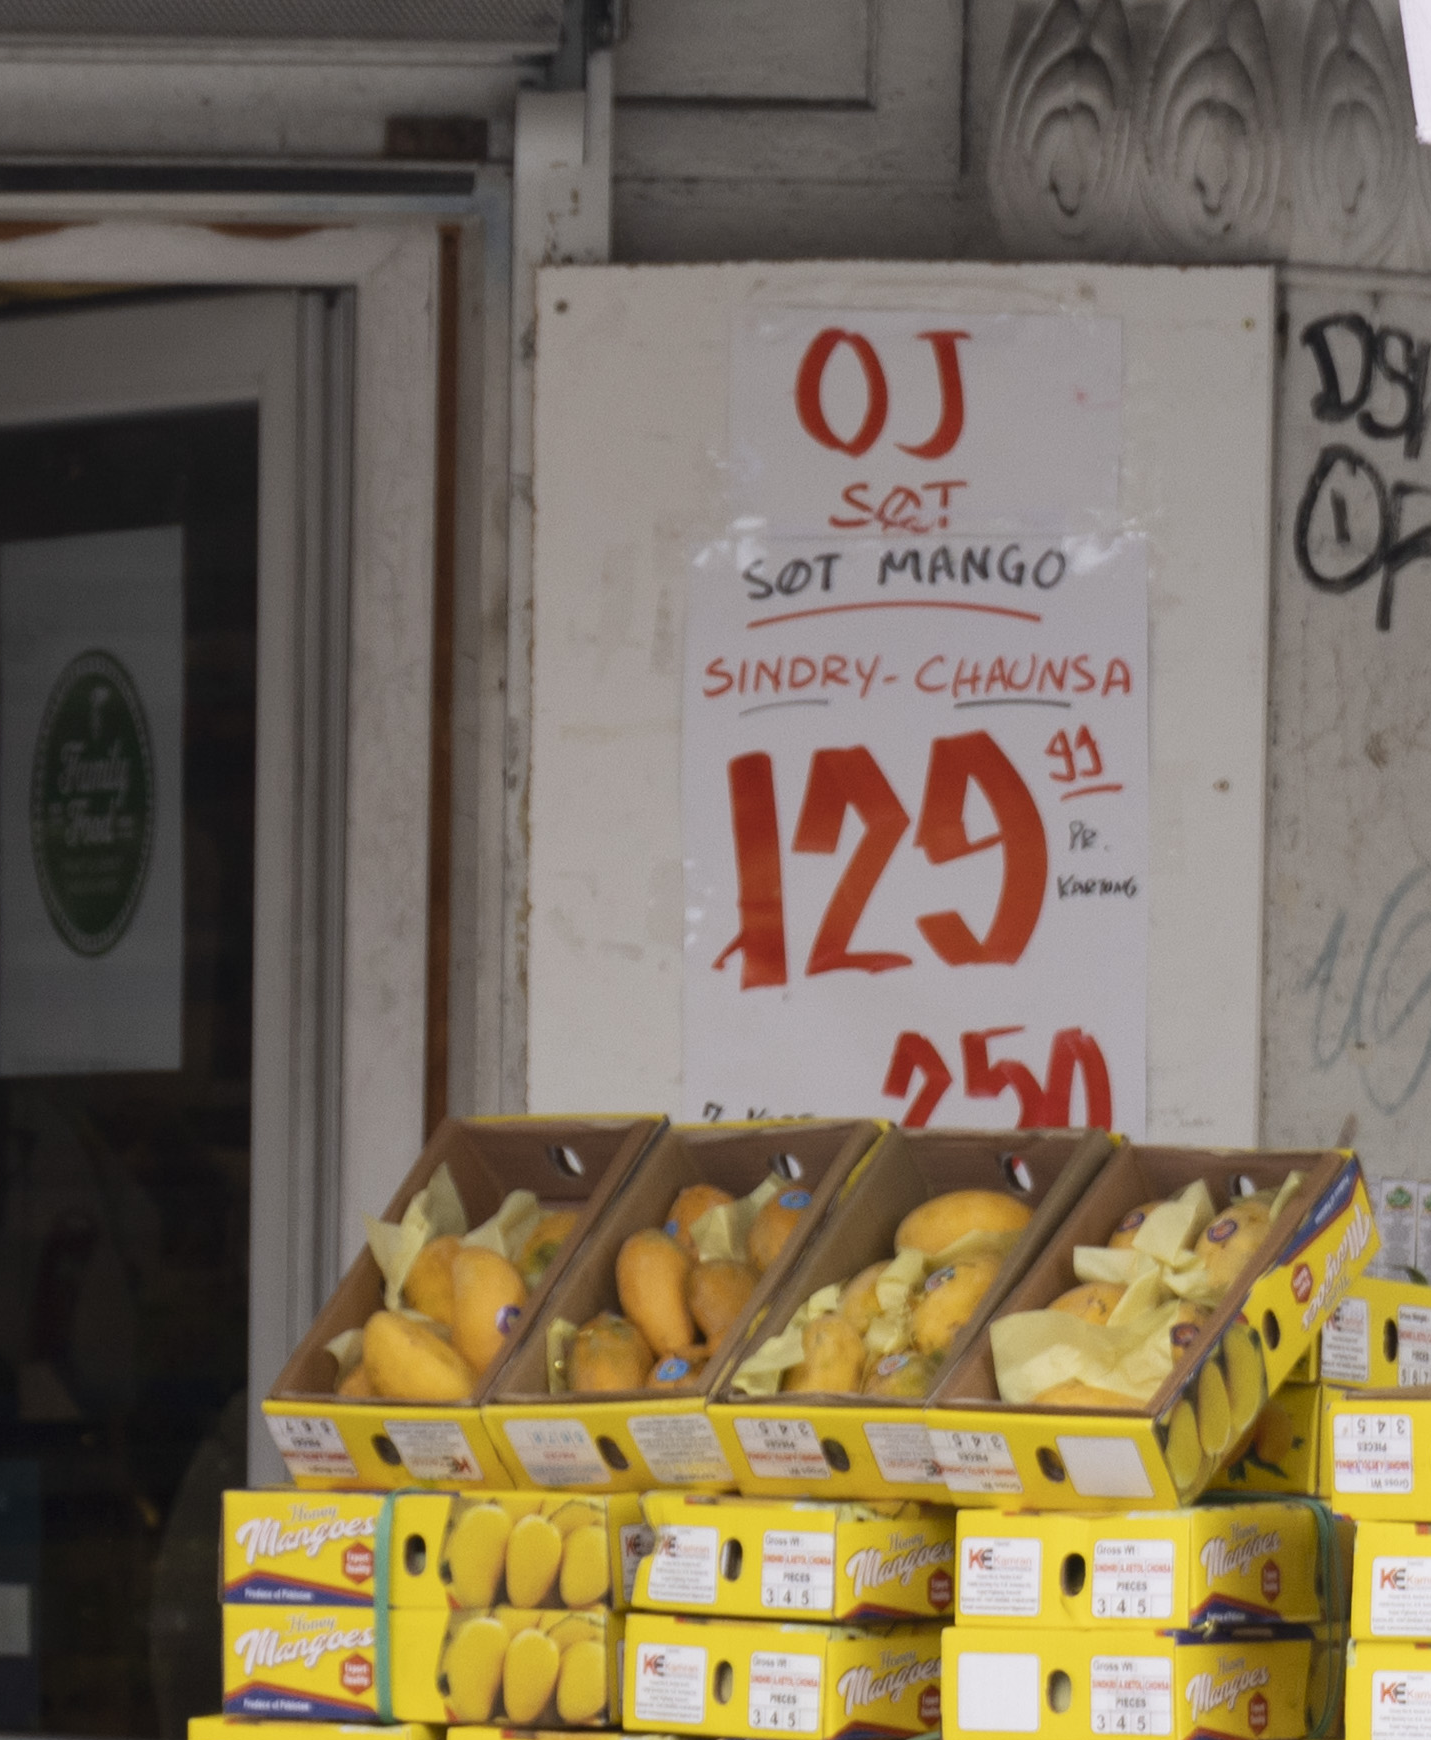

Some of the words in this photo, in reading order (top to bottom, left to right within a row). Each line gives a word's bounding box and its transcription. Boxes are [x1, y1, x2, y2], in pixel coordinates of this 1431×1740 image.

[795, 327, 972, 459] OJ
[742, 552, 841, 598] SØT
[878, 543, 1069, 591] MANGO
[915, 655, 1134, 697] CHAUNSA
[57, 740, 131, 800] Family
[63, 798, 117, 848] Food
[711, 728, 1050, 991] 129
[288, 1502, 336, 1522] Honey
[235, 1516, 376, 1564] Mangoes
[344, 1552, 371, 1564] Export
[344, 1564, 371, 1576] Quality
[1380, 1568, 1406, 1591] KE
[244, 1587, 275, 1599] Produce
[285, 1590, 313, 1601] Pakistan
